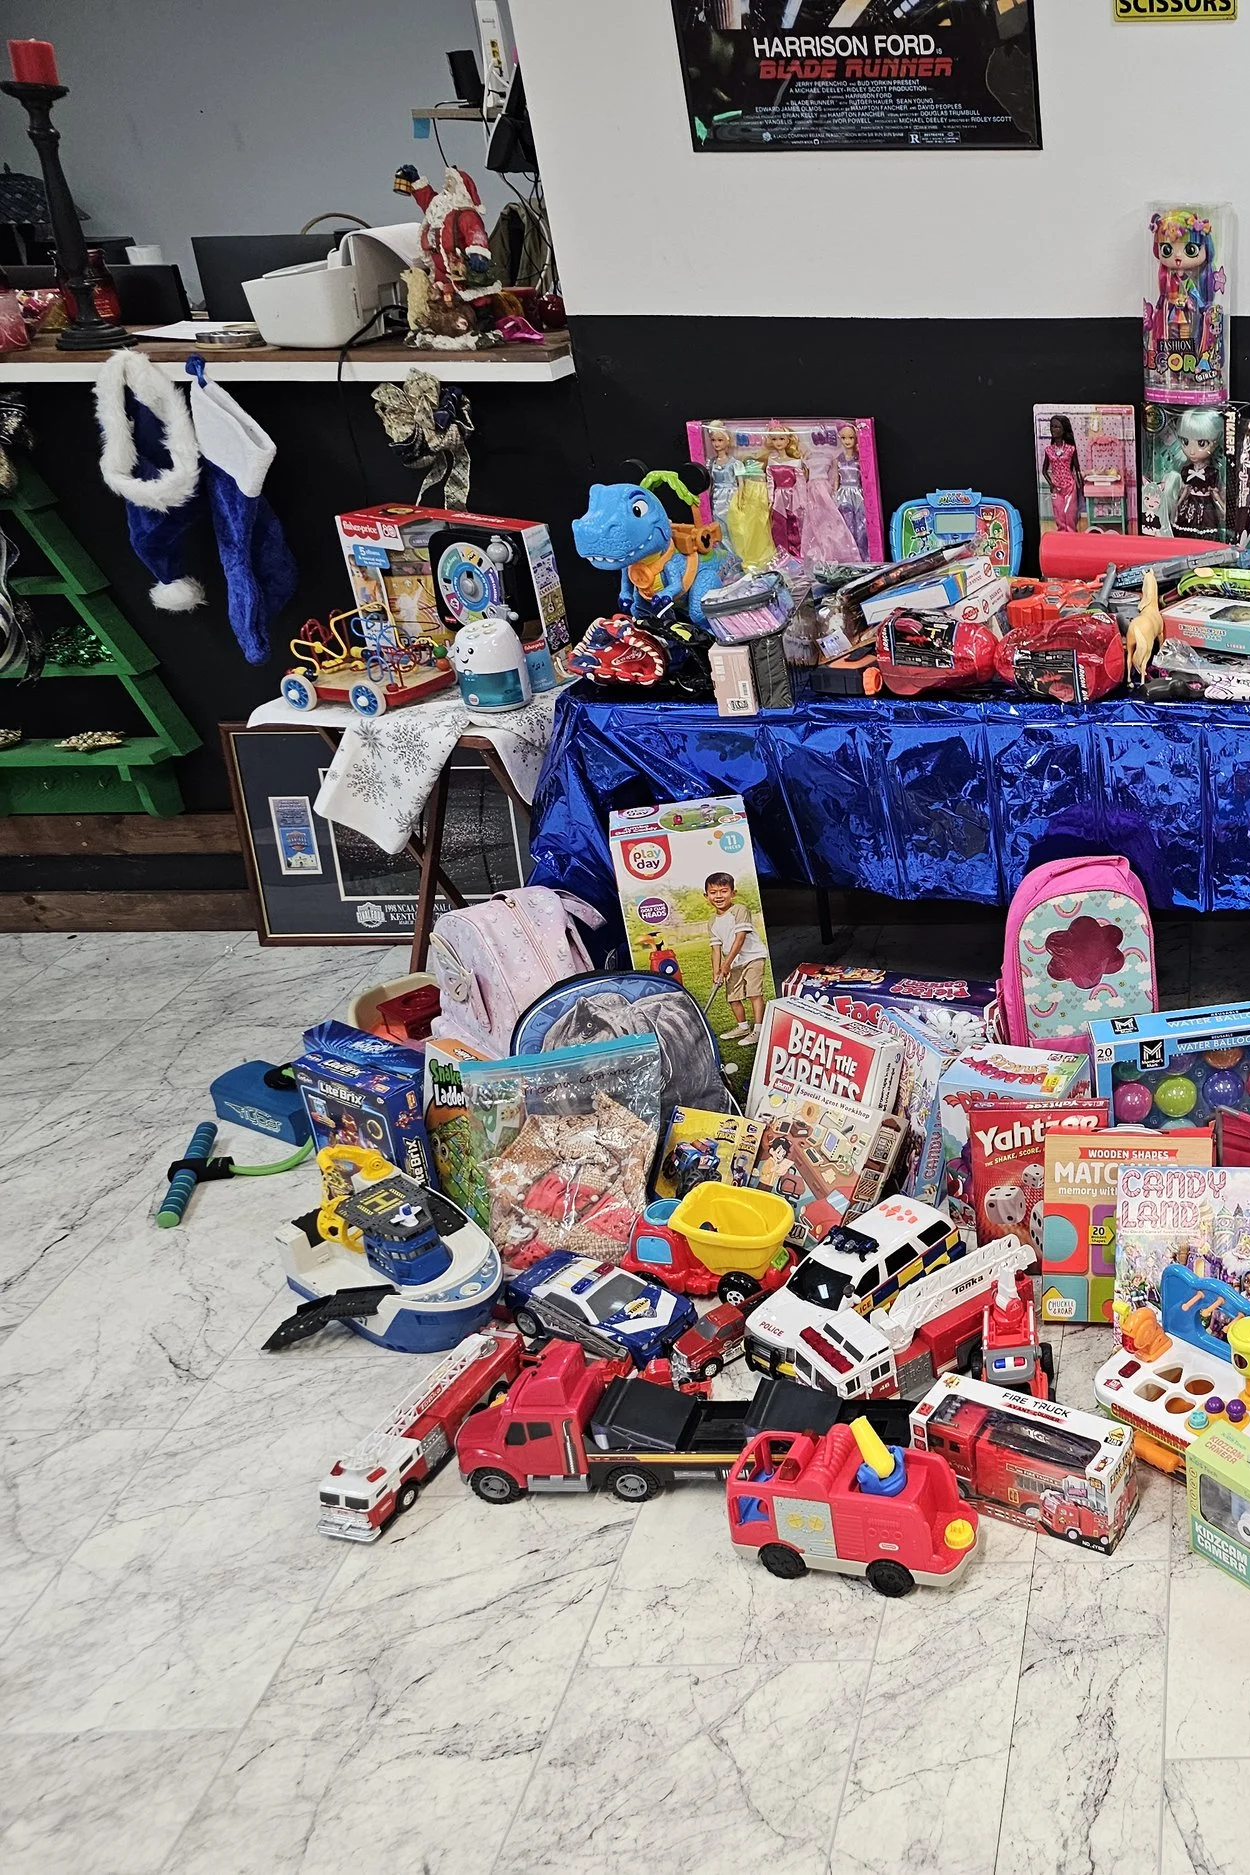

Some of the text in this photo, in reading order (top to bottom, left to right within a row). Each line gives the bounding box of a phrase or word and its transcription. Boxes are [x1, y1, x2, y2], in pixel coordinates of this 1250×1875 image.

[753, 34, 935, 58] HARRISON FORD
[759, 57, 953, 79] BLADE RUNNER
[1160, 340, 1192, 351] FASHION
[725, 834, 738, 845] 11
[633, 847, 661, 862] play
[636, 857, 660, 870] day
[390, 912, 417, 921] KENTU
[641, 910, 667, 919] HEADS
[834, 996, 883, 1025] Fac
[1166, 1018, 1211, 1029] WATER
[787, 1019, 858, 1077] BEAT THE
[1097, 1048, 1113, 1058] 20
[1176, 1041, 1211, 1052] WATER
[429, 1059, 463, 1084] Snake
[769, 1046, 861, 1102] PARENTS
[434, 1084, 469, 1107] Ladder
[799, 1088, 871, 1119] Special Agent Workshop
[993, 1147, 1042, 1164] SHAKE, SCORE,
[1088, 1150, 1169, 1160] WOODEN SHAPES
[1058, 1187, 1094, 1198] memory
[1121, 1169, 1227, 1199] CANDY
[1121, 1200, 1200, 1229] LAND
[1092, 1226, 1105, 1237] 20
[952, 1273, 985, 1295] Tonka
[628, 1299, 649, 1315] Tonka
[1047, 1300, 1075, 1309] CHUCKLE
[758, 1320, 785, 1338] POLICE
[1002, 1392, 1072, 1419] FIRE TRUCK
[1195, 1521, 1248, 1567] KIDZCAM
[1196, 1533, 1247, 1577] CAMERA
